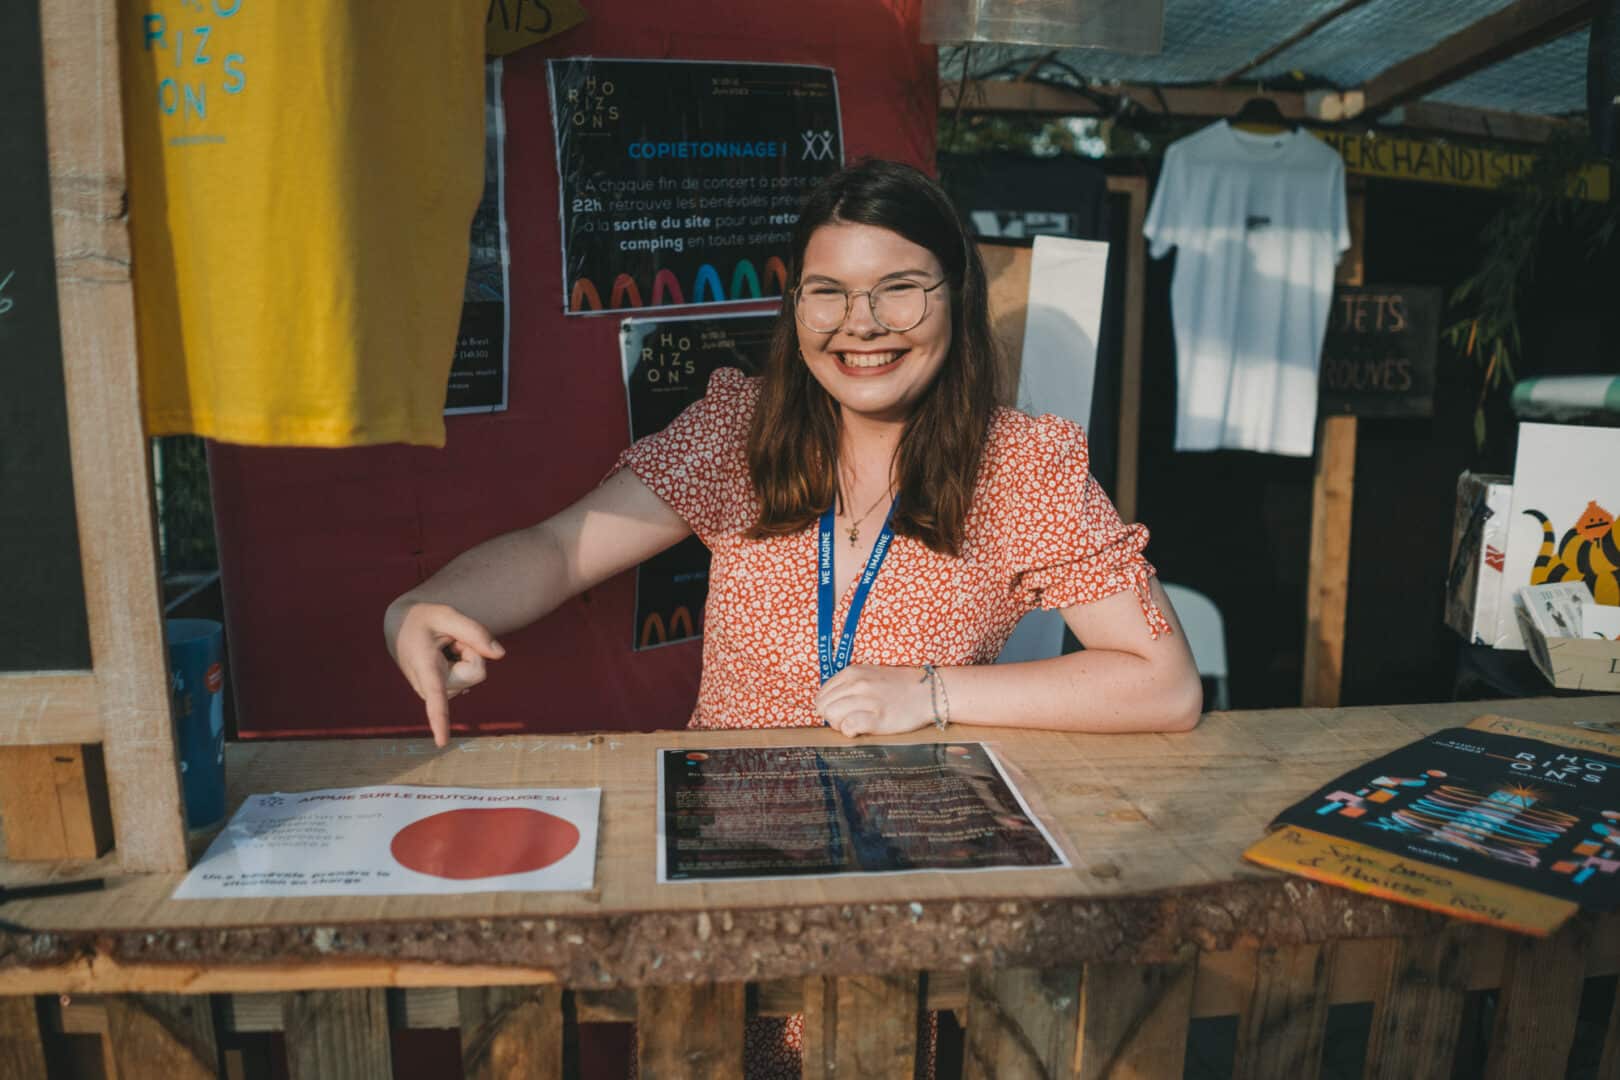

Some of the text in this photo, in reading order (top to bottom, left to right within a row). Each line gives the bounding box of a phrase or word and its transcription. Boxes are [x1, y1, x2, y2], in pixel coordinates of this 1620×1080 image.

[599, 176, 654, 195] chaque
[658, 177, 677, 190] fin
[681, 177, 699, 190] de
[703, 177, 756, 190] concert
[609, 198, 672, 212] retrouve
[676, 195, 697, 209] les
[613, 217, 657, 232] sortie
[660, 215, 682, 229] du
[684, 214, 712, 228] site
[715, 215, 747, 231] pour
[749, 215, 768, 226] un
[769, 213, 801, 225] reto
[619, 230, 793, 252] camping en toute sérénit
[822, 532, 831, 585] WE IMAGINE
[862, 533, 891, 585] WE IMAGINE
[834, 632, 850, 674] eolis
[296, 792, 356, 804] APPUIE
[359, 792, 391, 801] SUR
[394, 792, 414, 801] LE
[415, 792, 485, 803] BOUTON
[487, 793, 544, 803] ROUGE
